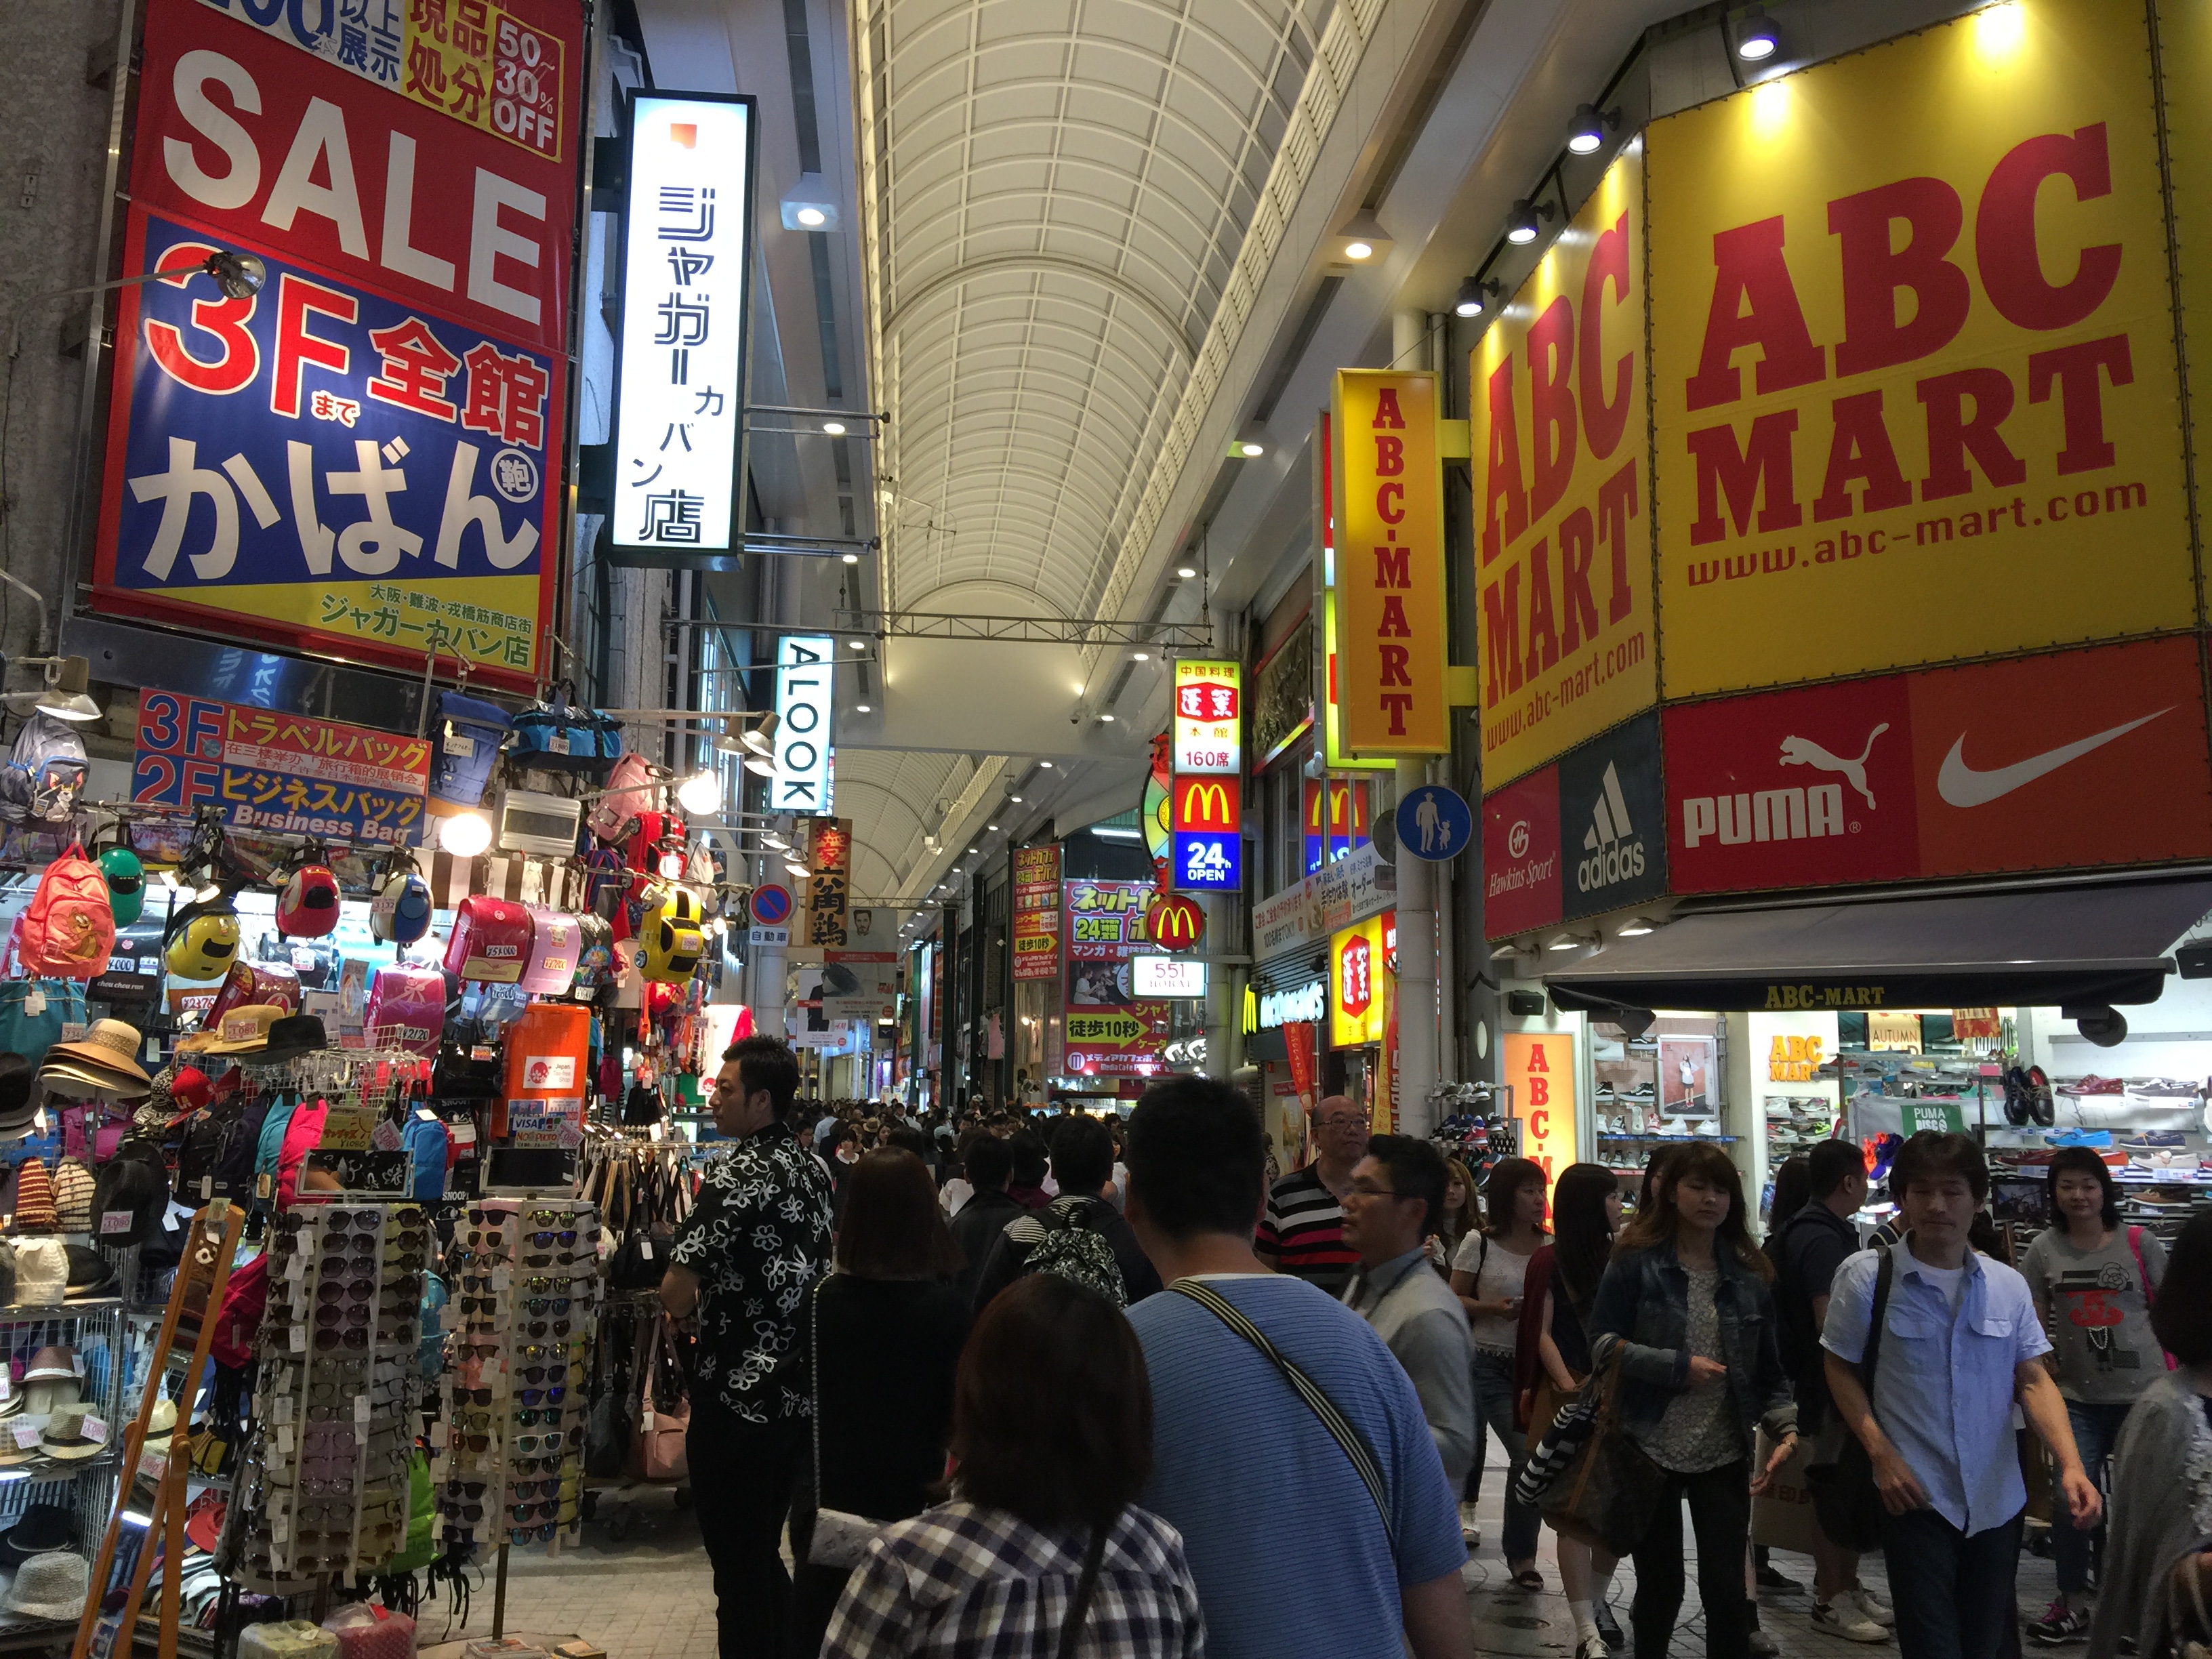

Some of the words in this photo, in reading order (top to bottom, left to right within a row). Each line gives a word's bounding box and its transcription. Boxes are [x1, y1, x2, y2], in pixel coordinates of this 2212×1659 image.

[337, 22, 401, 83] 展示
[407, 36, 487, 122] 処分
[496, 59, 554, 114] 30%
[493, 98, 555, 149] OFF
[163, 49, 546, 326] SALE
[1686, 121, 2123, 412] ABC
[144, 241, 359, 419] 3F
[311, 389, 361, 428] まで
[367, 316, 550, 451] 全館
[1481, 207, 1634, 569] ABC
[1687, 333, 2135, 546] MART
[127, 434, 540, 582] かばん
[1687, 482, 2148, 588] www.abc-mart.com
[1372, 388, 1413, 737] ABC-MART
[1483, 457, 1639, 710] MART
[321, 594, 531, 668] ジャガーカバン店
[1181, 665, 1235, 678] 中国料理
[1487, 630, 1646, 753] www.abc-mart.com
[140, 693, 225, 758] 3F
[226, 708, 428, 771] トラベルバッグ
[783, 642, 820, 802] ALOOK
[1186, 751, 1230, 767] 160席
[134, 754, 220, 819] 2F
[222, 769, 424, 826] ビジネスバッグ
[234, 804, 354, 836] Business
[1683, 783, 1845, 848] PUMA
[1187, 869, 1225, 882] OPEN
[1489, 867, 1525, 898] Hawkins
[1526, 857, 1553, 889] Sport
[1578, 839, 1645, 893] adidas
[751, 930, 788, 943] 自動車
[1155, 963, 1185, 979] 551
[1765, 984, 1885, 1010] ABC-MART
[1069, 1020, 1140, 1038] 徒歩10秒
[1769, 1035, 1824, 1062] ABC
[1872, 1029, 1918, 1043] AUTUMN
[516, 1118, 538, 1128] VISA
[1913, 1107, 1946, 1120] PUMA
